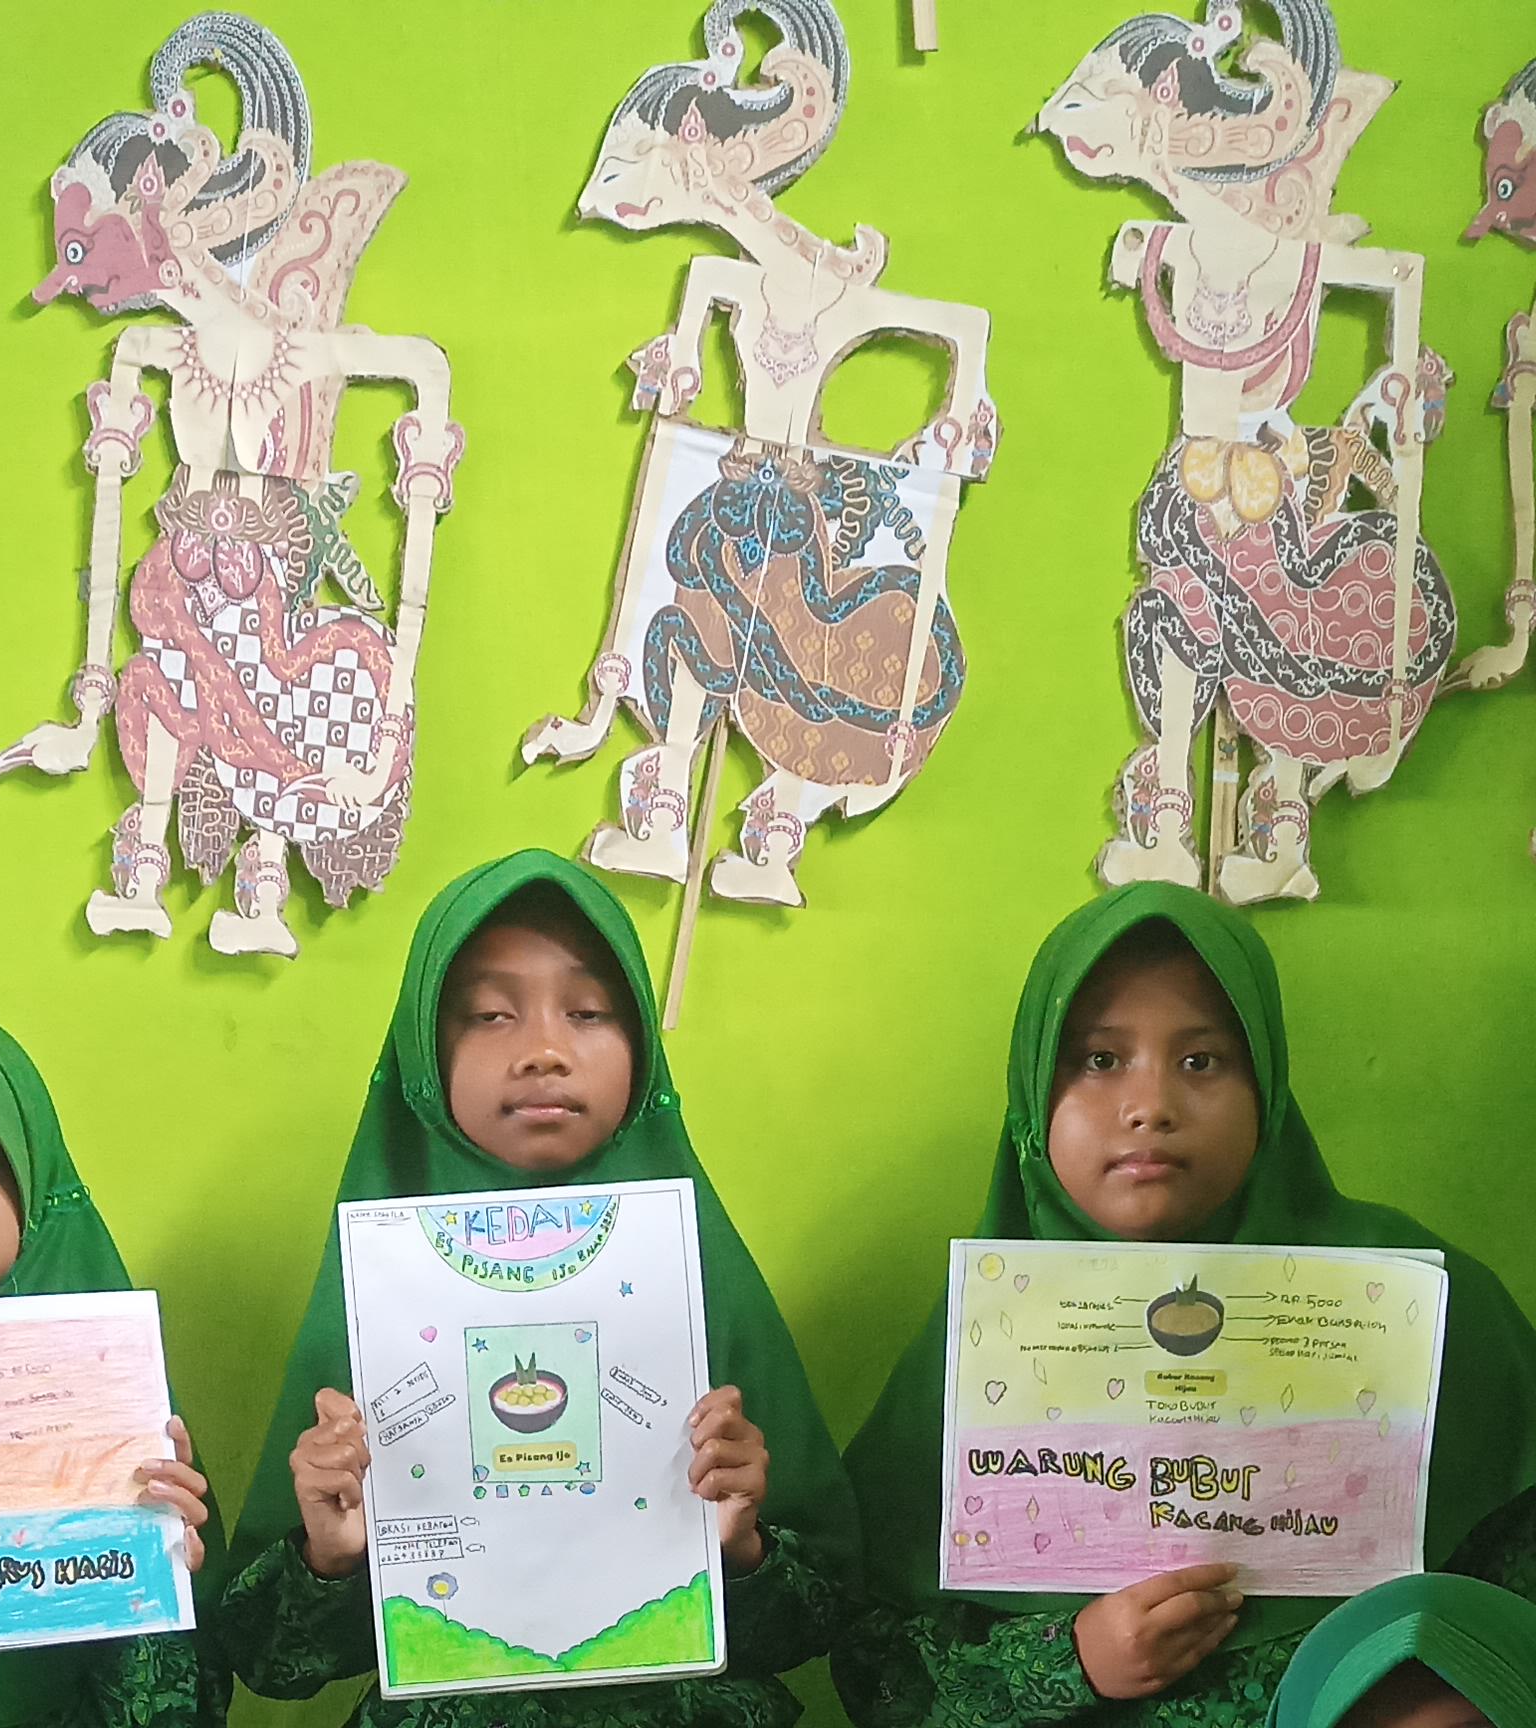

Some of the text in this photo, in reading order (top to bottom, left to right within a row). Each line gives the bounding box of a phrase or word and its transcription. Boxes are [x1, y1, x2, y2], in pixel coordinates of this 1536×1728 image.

[463, 1203, 572, 1247] KEDAI
[434, 1231, 454, 1257] ES
[1306, 1294, 1344, 1310] 5000
[499, 1454, 514, 1463] Es
[515, 1452, 554, 1462] Pisang
[967, 1448, 1137, 1492] WARUNG
[1148, 1500, 1265, 1536] KACANG
